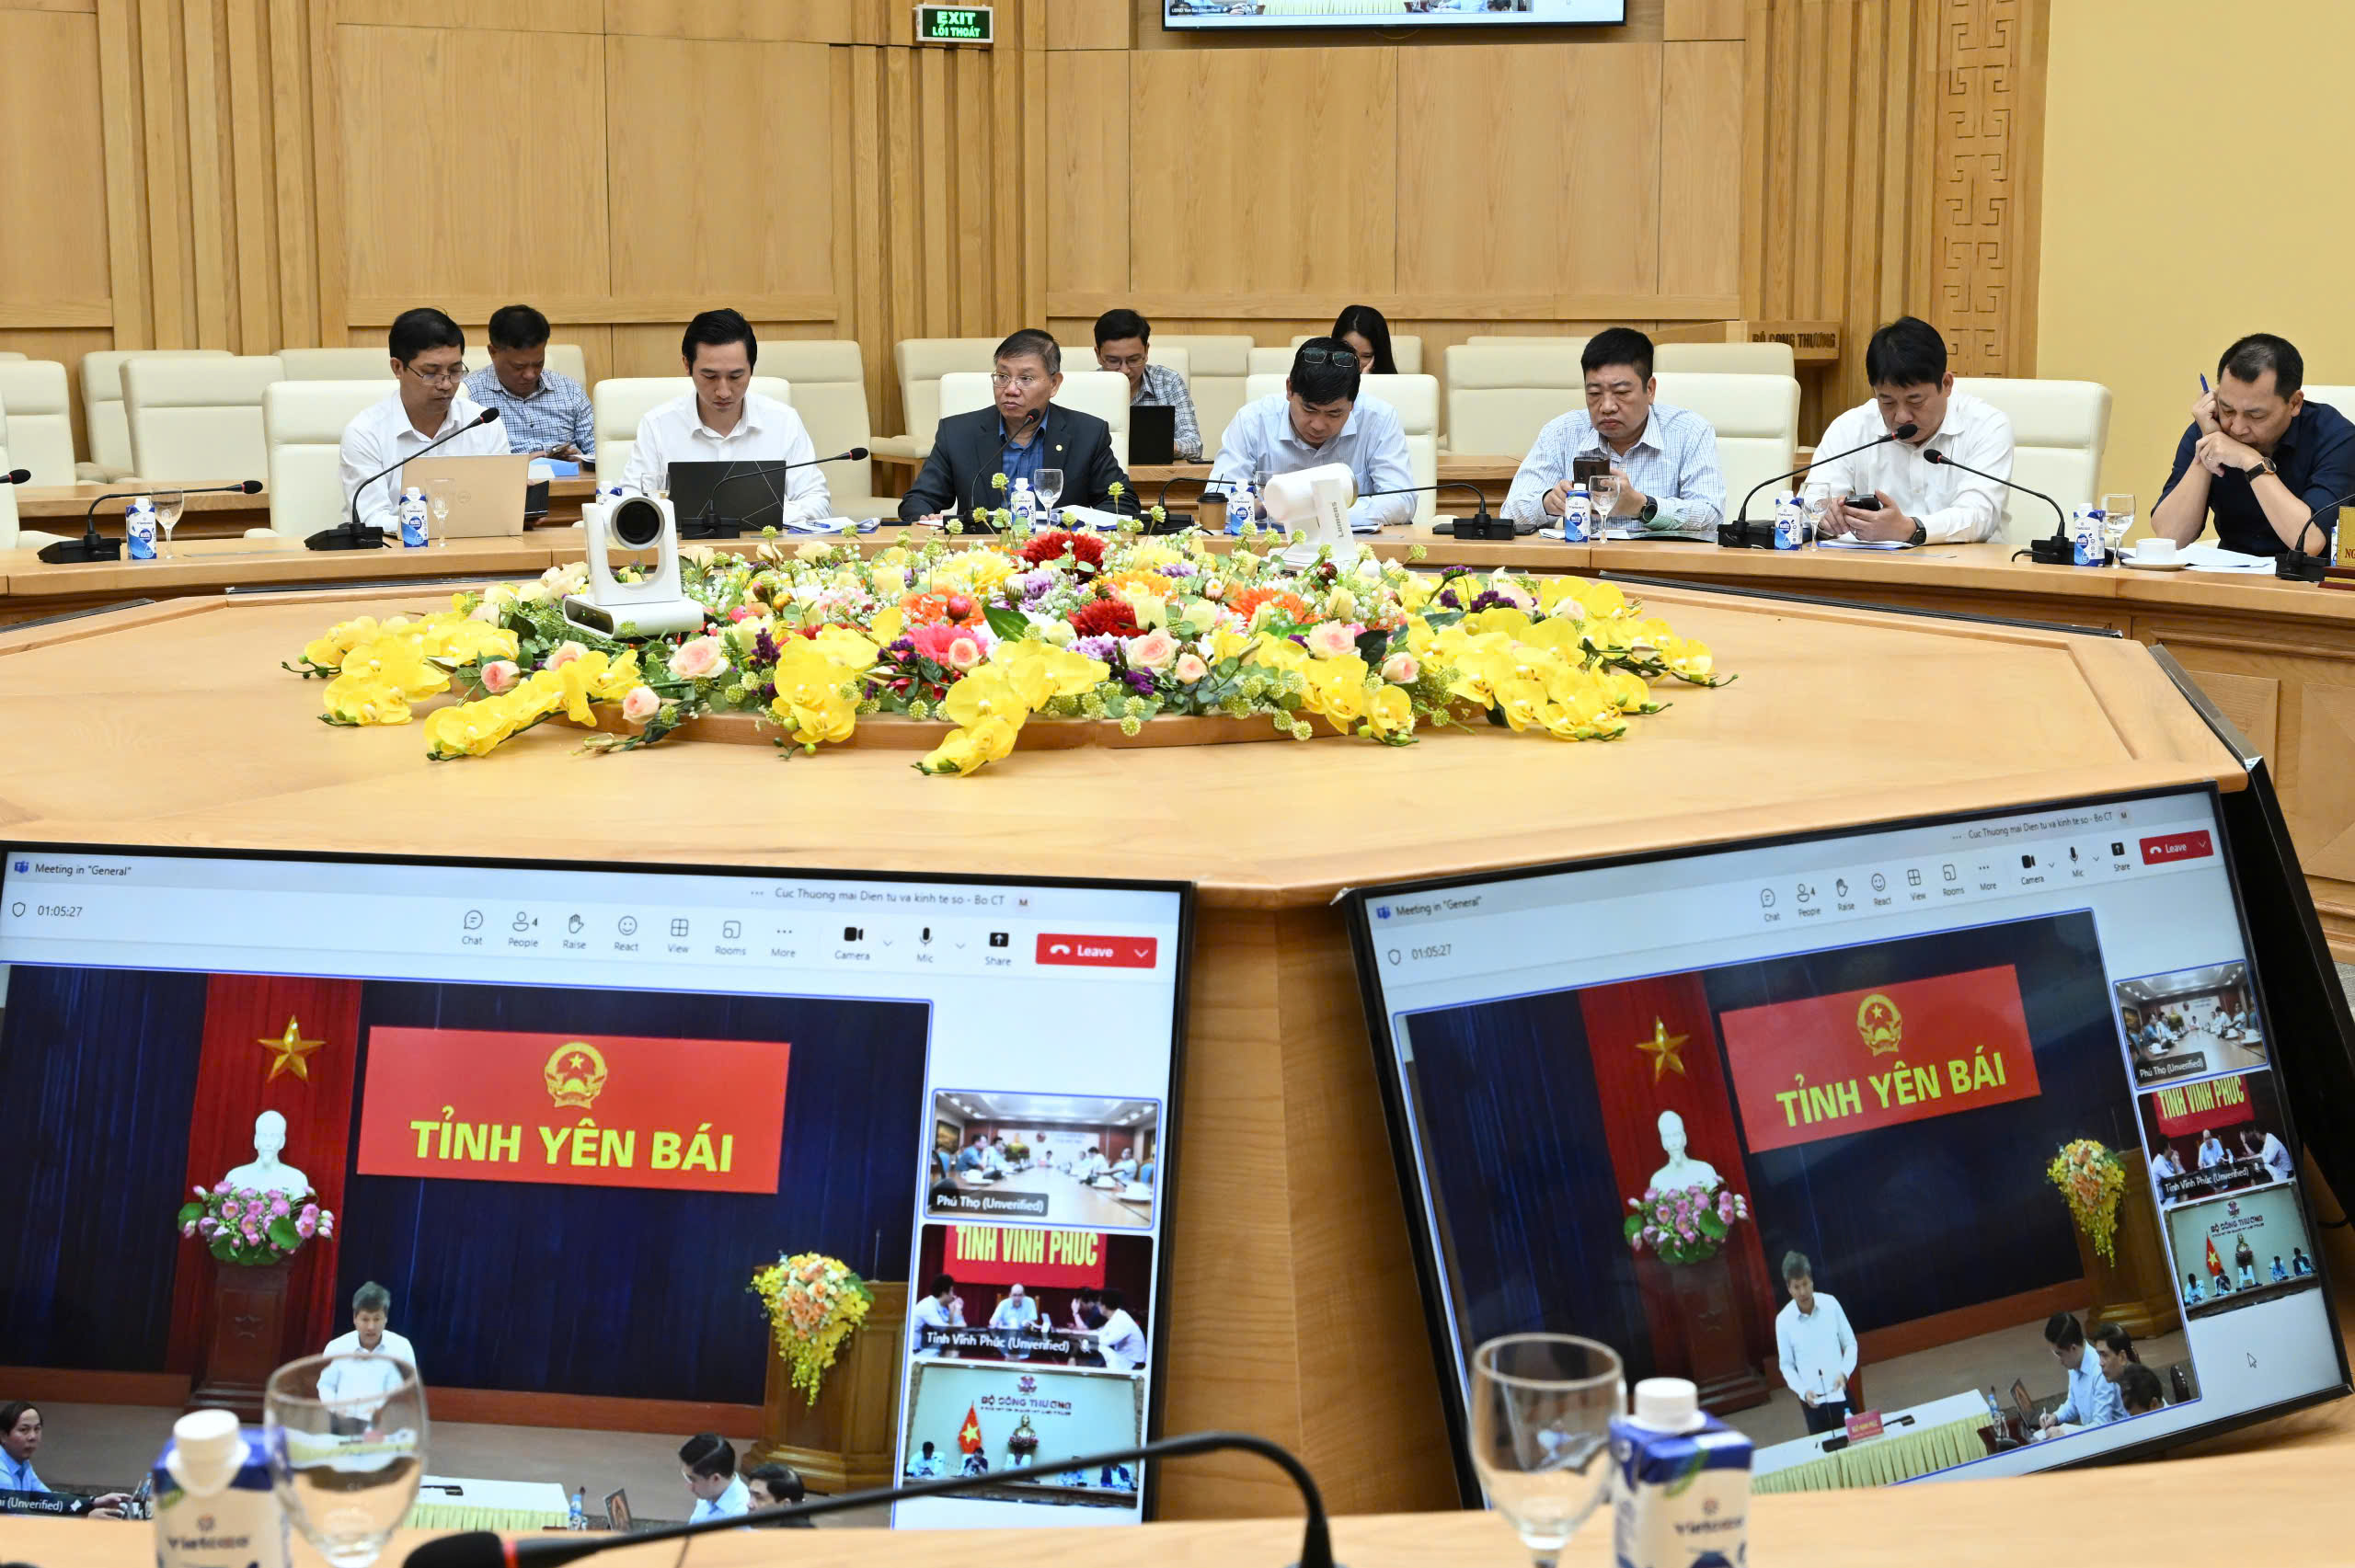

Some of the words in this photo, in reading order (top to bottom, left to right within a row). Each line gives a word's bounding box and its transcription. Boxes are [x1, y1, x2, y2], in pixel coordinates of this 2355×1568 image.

[936, 11, 976, 25] EXIT
[950, 26, 981, 37] THOÁT
[1331, 501, 1344, 538] Lumens
[1969, 829, 1982, 839] Cuc
[1982, 827, 2009, 837] Thuong
[2024, 822, 2039, 831] Dien
[2057, 818, 2072, 827] kinh
[2094, 813, 2104, 822] Bo
[2104, 811, 2113, 820] CT
[2165, 842, 2188, 853] Leave
[35, 864, 73, 876] Meeting
[75, 865, 85, 875] in
[87, 865, 132, 876] "General"
[2072, 869, 2084, 877] Mic
[2113, 862, 2131, 872] Share
[1980, 881, 1997, 891] More
[2020, 874, 2045, 886] Camera
[775, 887, 794, 898] Cuc
[797, 888, 836, 903] Thuong
[838, 892, 857, 900] mai
[860, 890, 883, 902] Dien
[886, 893, 897, 902] tu
[913, 892, 936, 903] kinh
[938, 895, 949, 904] te
[951, 897, 965, 905] so
[974, 895, 988, 906] Bo
[991, 895, 1005, 906] CT
[1910, 891, 1926, 901] View
[1942, 887, 1965, 897] Rooms
[1396, 904, 1431, 917] Meeting
[1433, 902, 1442, 911] in
[1443, 896, 1482, 910] "General"
[1837, 901, 1855, 911] Raise
[1873, 896, 1892, 907] React
[37, 905, 83, 918] 01:05:27
[1763, 911, 1781, 922] Chat
[1798, 906, 1821, 919] People
[532, 918, 539, 927] 4
[461, 935, 483, 946] Chat
[508, 937, 539, 949] People
[562, 939, 587, 950] Raise
[614, 941, 639, 953] React
[667, 944, 690, 954] View
[715, 945, 747, 956] Rooms
[771, 947, 797, 958] More
[1076, 944, 1115, 959] Leave
[1411, 944, 1453, 960] 01:05:27
[833, 950, 870, 962] Camera
[916, 953, 934, 965] Mic
[984, 956, 1012, 967] Share
[2139, 1068, 2154, 1079] Phú
[2166, 1058, 2204, 1075] (Unverified)
[1775, 1073, 1863, 1127] TỈNH
[1868, 1060, 1941, 1109] YÊN
[1947, 1045, 2006, 1094] BÁI
[410, 1105, 523, 1162] TỈNH
[537, 1118, 636, 1168] YÊN
[650, 1123, 734, 1173] BÁI
[2212, 1166, 2249, 1184] (Unverified)
[936, 1195, 958, 1207] Phú
[959, 1196, 982, 1210] Thọ
[982, 1196, 1044, 1213] (Unverified)
[1007, 1336, 1071, 1354] (Unverified)
[6, 1496, 64, 1513] (Unverified)
